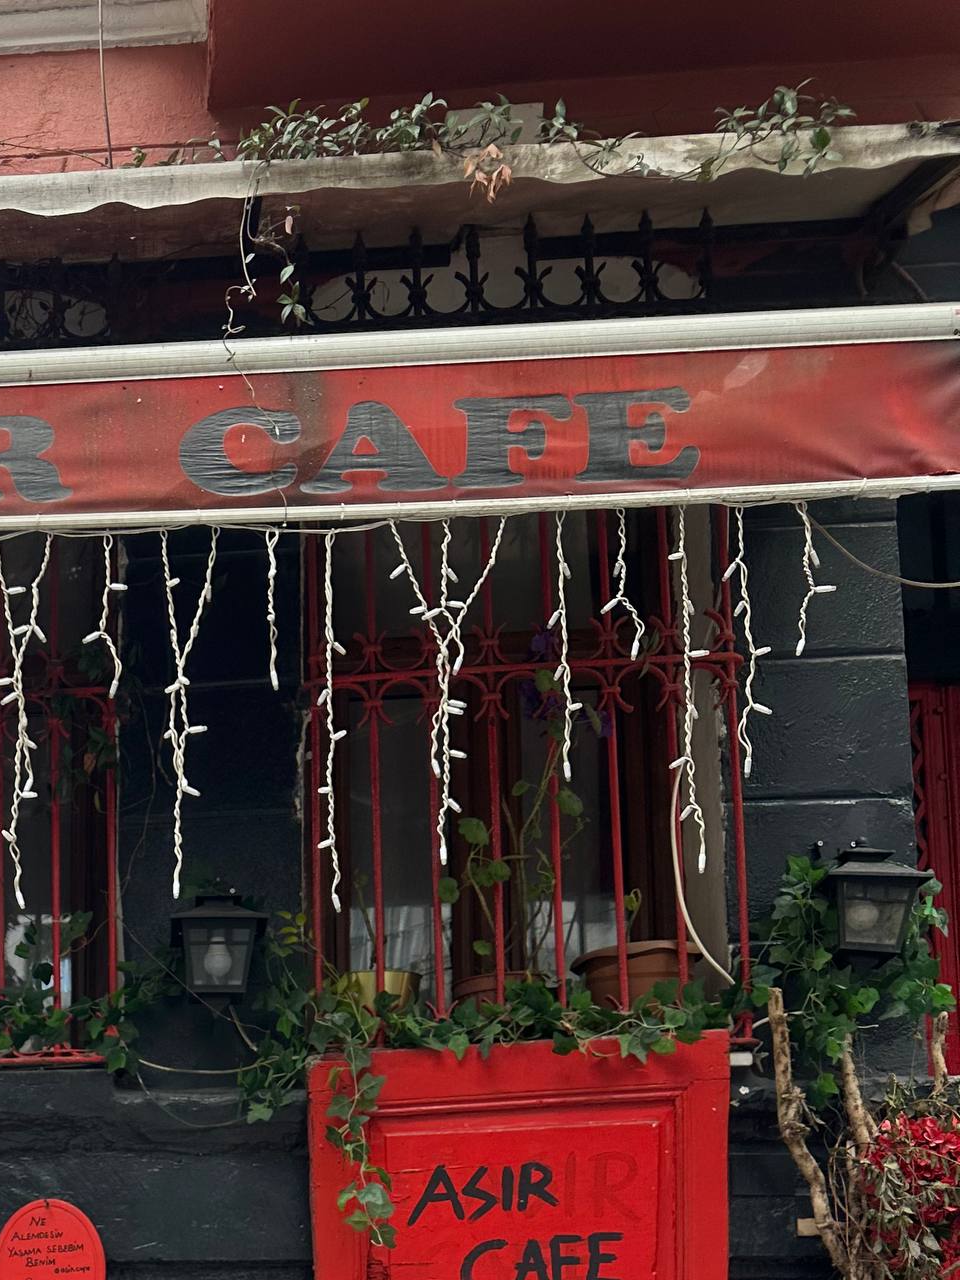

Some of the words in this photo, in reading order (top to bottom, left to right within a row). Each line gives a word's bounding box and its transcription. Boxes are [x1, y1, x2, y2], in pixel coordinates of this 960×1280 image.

[179, 387, 701, 496] CAFE
[29, 1216, 46, 1226] NE
[407, 1161, 560, 1227] ASIR
